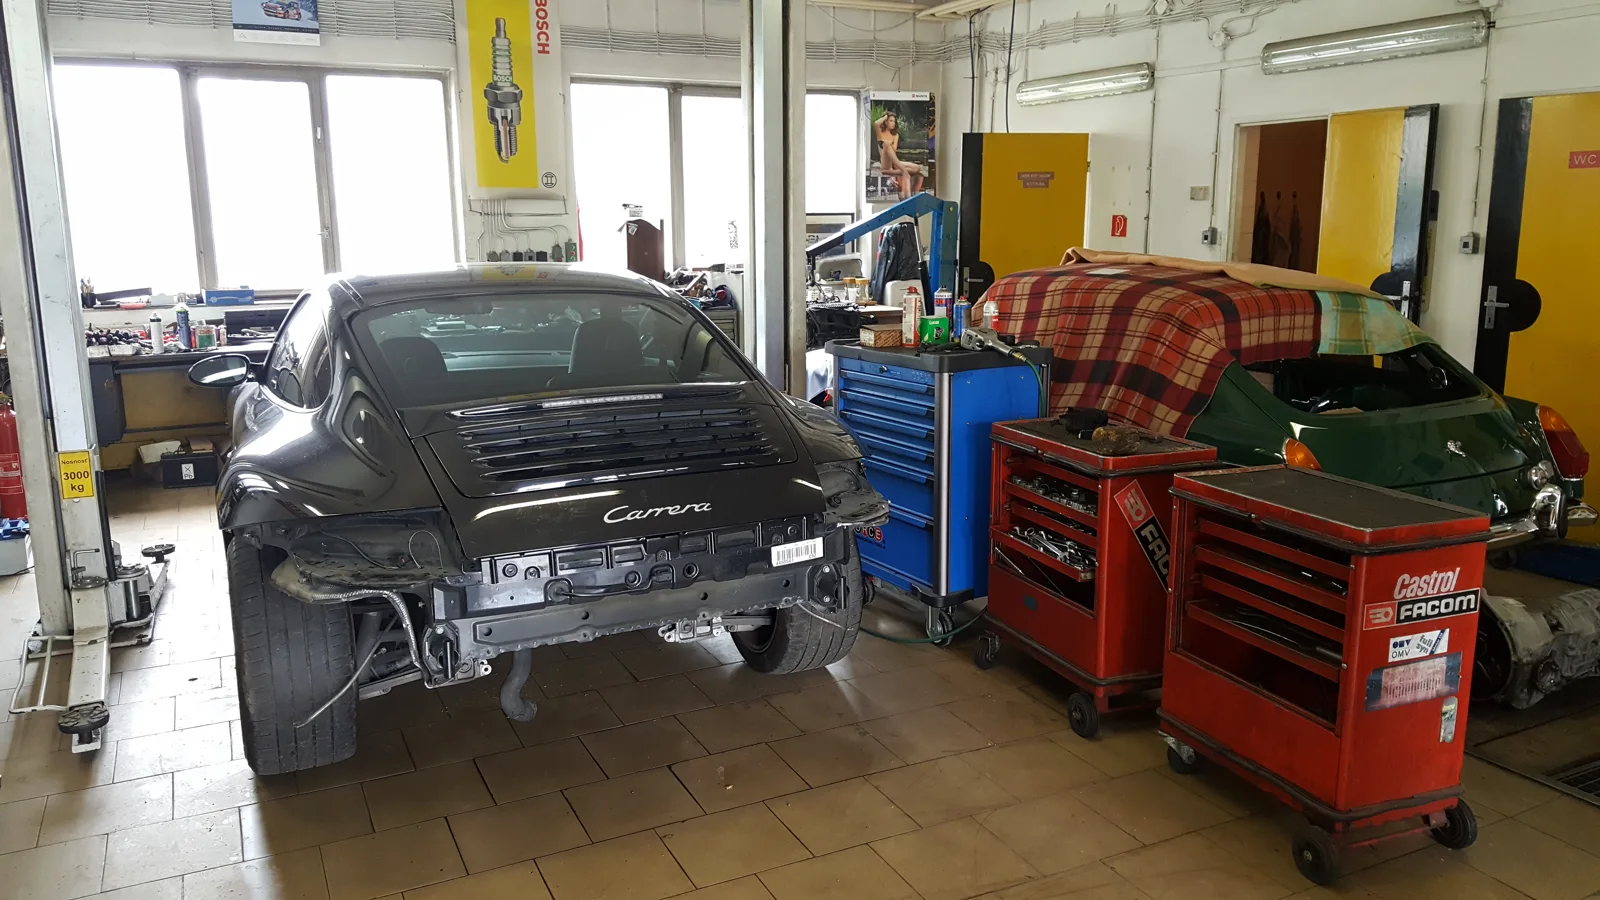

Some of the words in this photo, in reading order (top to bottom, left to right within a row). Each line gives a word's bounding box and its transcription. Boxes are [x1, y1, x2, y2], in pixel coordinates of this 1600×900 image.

[1573, 154, 1597, 165] WC
[63, 470, 89, 481] 3000
[70, 483, 84, 493] kg
[603, 502, 713, 524] Carrera
[1140, 524, 1171, 583] FAC
[1393, 567, 1460, 599] Castrol
[1399, 594, 1476, 621] FACOM
[1419, 634, 1434, 648] full
[1391, 648, 1411, 659] OMV
[1415, 642, 1429, 655] syn
